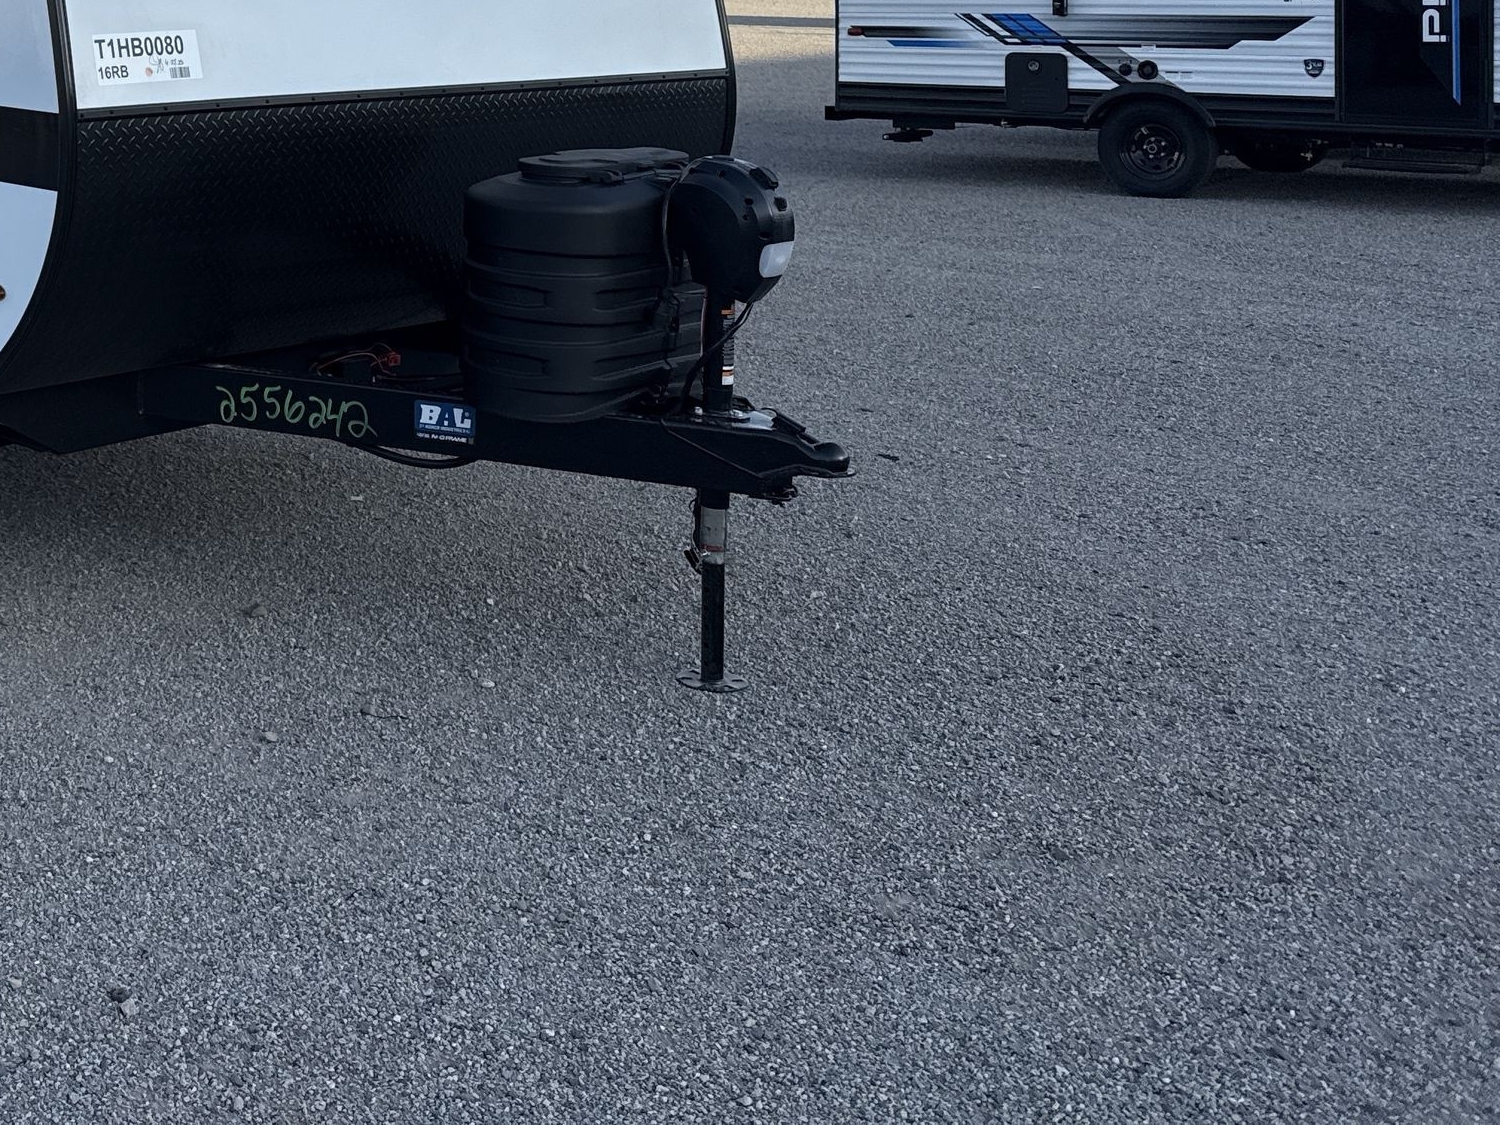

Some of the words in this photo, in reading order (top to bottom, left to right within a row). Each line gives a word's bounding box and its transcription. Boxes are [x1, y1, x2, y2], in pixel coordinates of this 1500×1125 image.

[94, 35, 184, 59] T1HB0080
[98, 65, 129, 80] 16RB
[215, 383, 379, 438] 2556242
[420, 404, 472, 429] BAL
